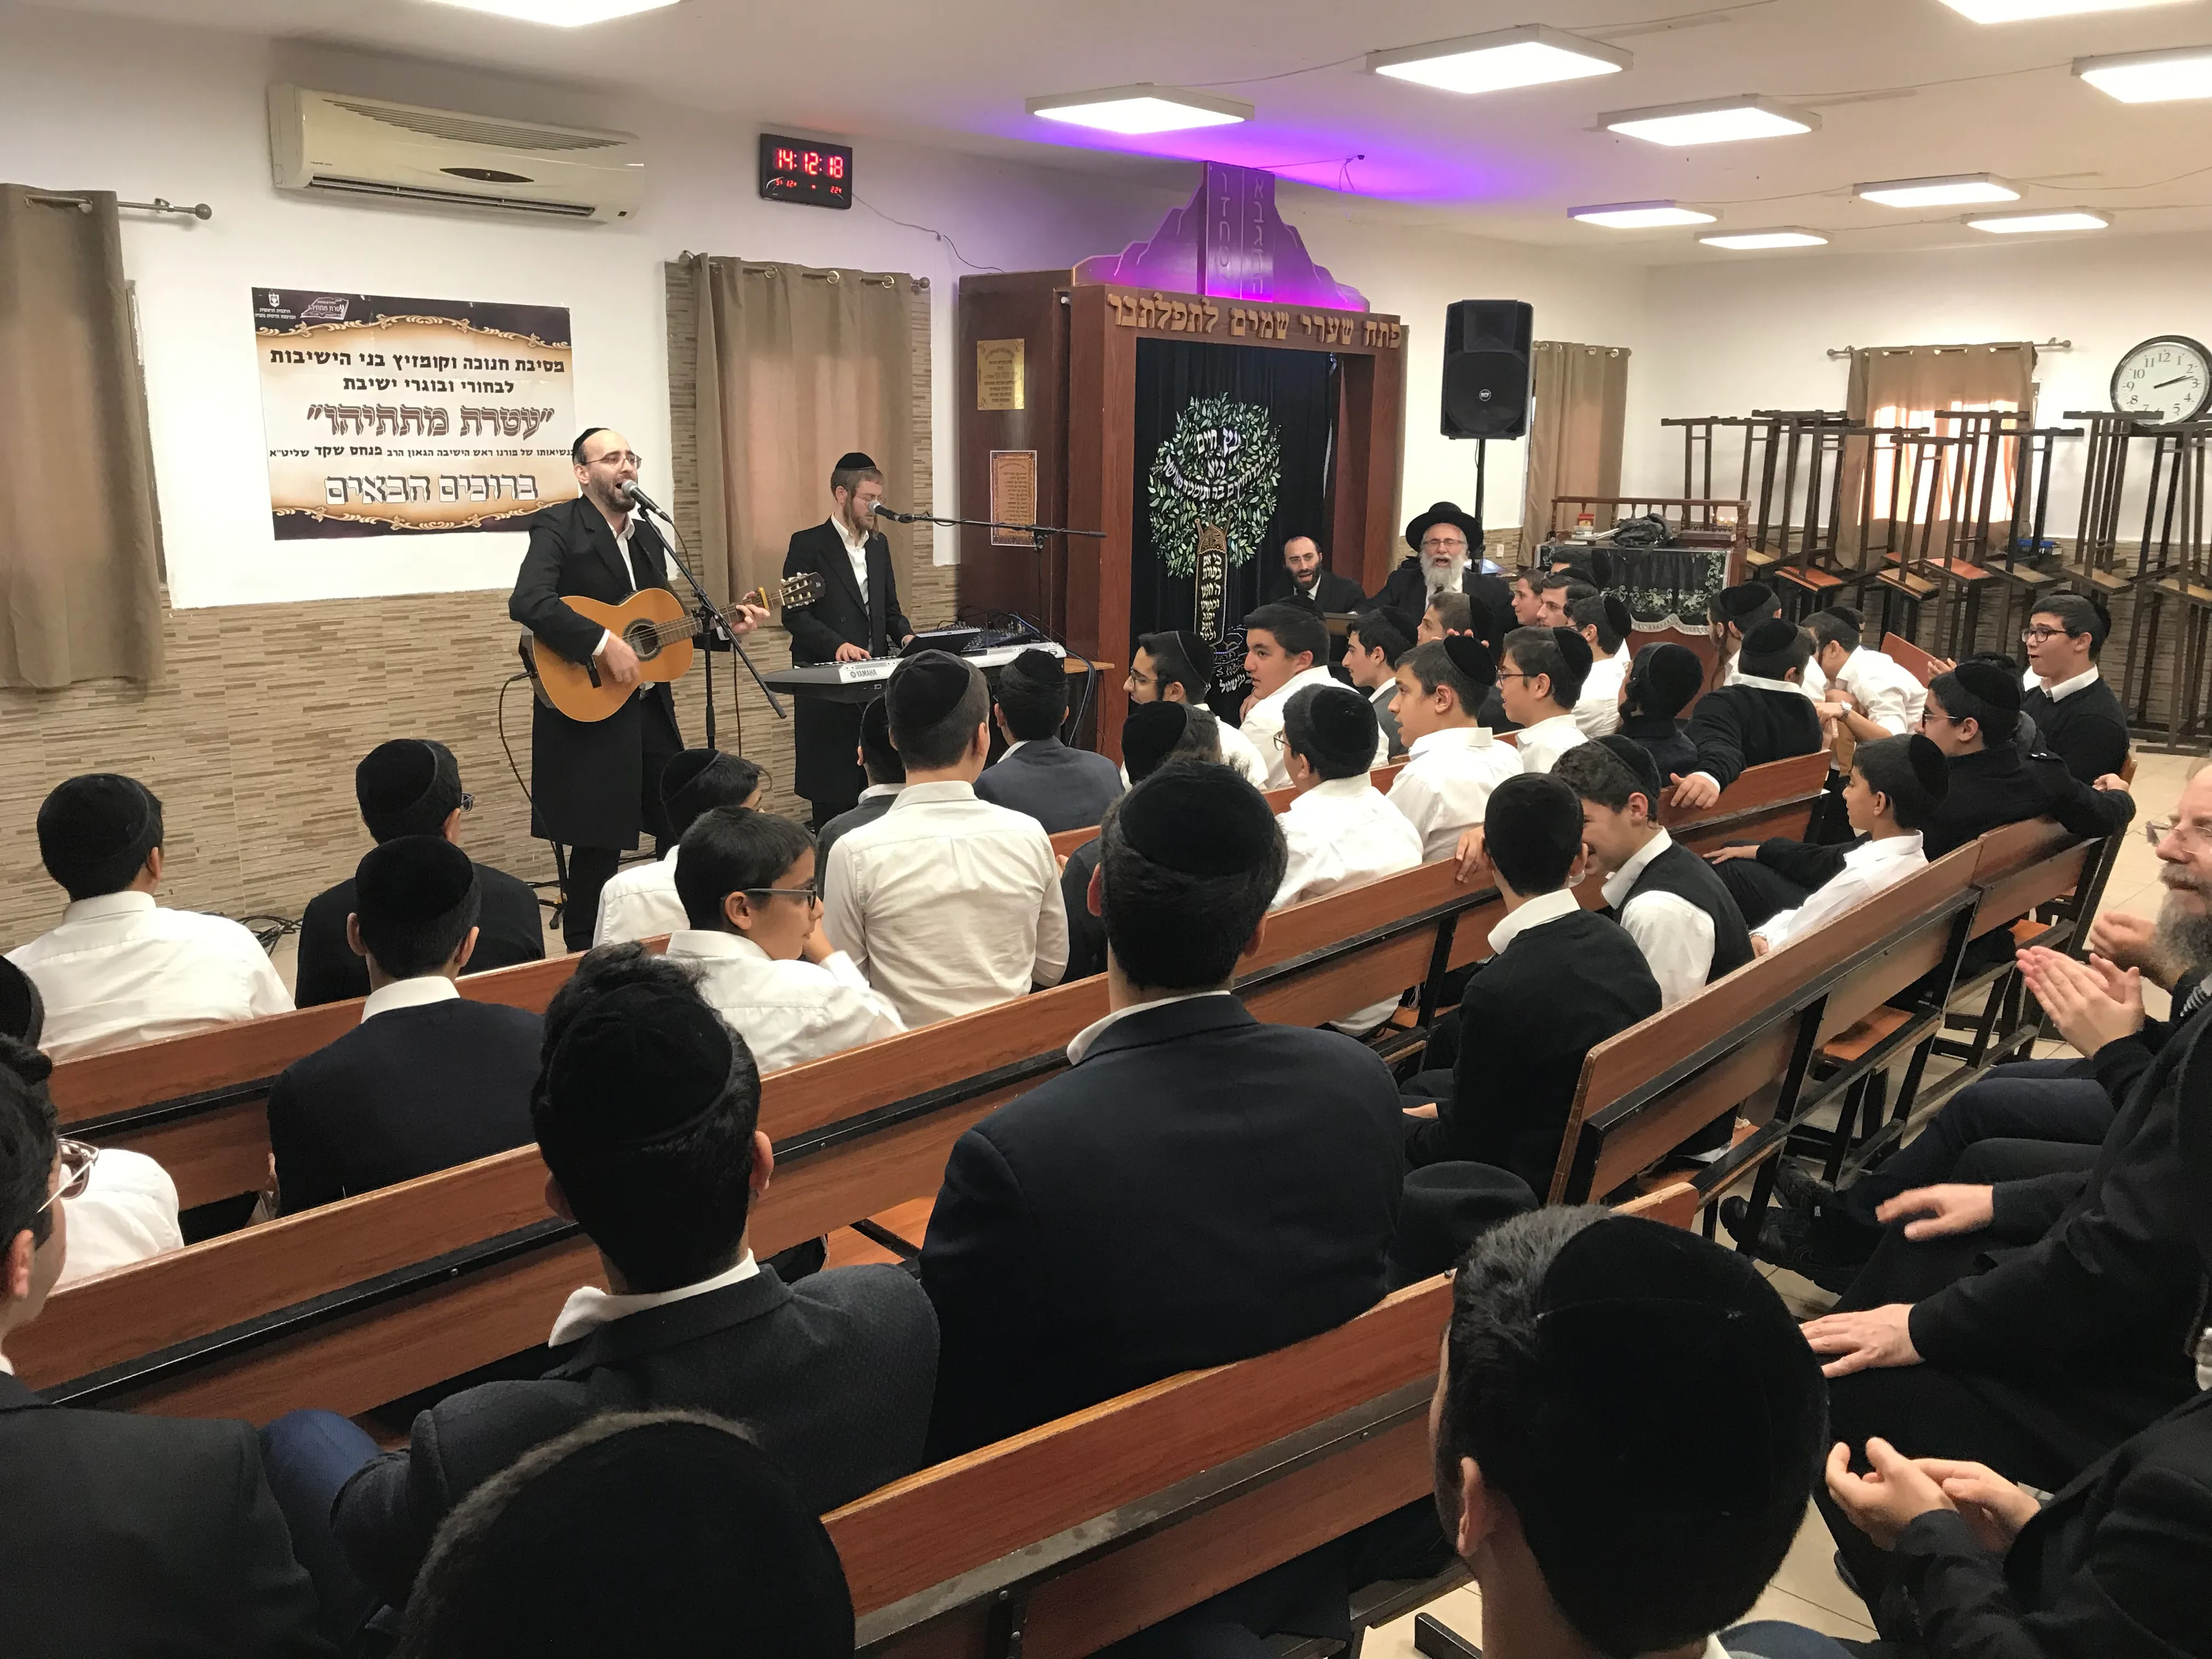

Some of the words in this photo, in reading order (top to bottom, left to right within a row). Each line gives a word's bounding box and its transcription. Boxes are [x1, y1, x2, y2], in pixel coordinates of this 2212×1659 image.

[777, 148, 843, 179] 14:12:18
[1229, 307, 1289, 340] שמים
[1299, 313, 1354, 345] שערי
[1363, 320, 1401, 348] פתח
[270, 349, 351, 365] הישיבות
[358, 353, 385, 366] בני
[392, 354, 457, 372] וקומזיץ
[2145, 358, 2154, 368] 11
[2158, 352, 2171, 362] 12
[2177, 356, 2182, 365] 1
[463, 357, 509, 371] חנוכה
[515, 359, 565, 373] מסיבת
[2186, 364, 2193, 374] 2
[2134, 369, 2145, 379] 10
[343, 377, 397, 391] ישיבת
[404, 379, 454, 392] ובוגרי
[461, 380, 514, 393] לבחורי
[2126, 381, 2135, 392] 9
[2191, 379, 2198, 388] 3
[2130, 395, 2138, 405] 8
[2183, 393, 2192, 403] 4
[2172, 403, 2181, 414] 5
[1197, 430, 1217, 454] חיים
[1223, 427, 1242, 458] עץ
[314, 445, 345, 458] שקד
[349, 446, 383, 456] פנחס
[407, 449, 433, 458] הגאון
[520, 448, 533, 456] של
[1208, 459, 1226, 478] היא
[324, 475, 431, 505] הבאים
[438, 475, 538, 503] ברוכים
[1212, 486, 1225, 500] בה
[1212, 552, 1222, 565] כי
[856, 669, 877, 678] YAMAHA
